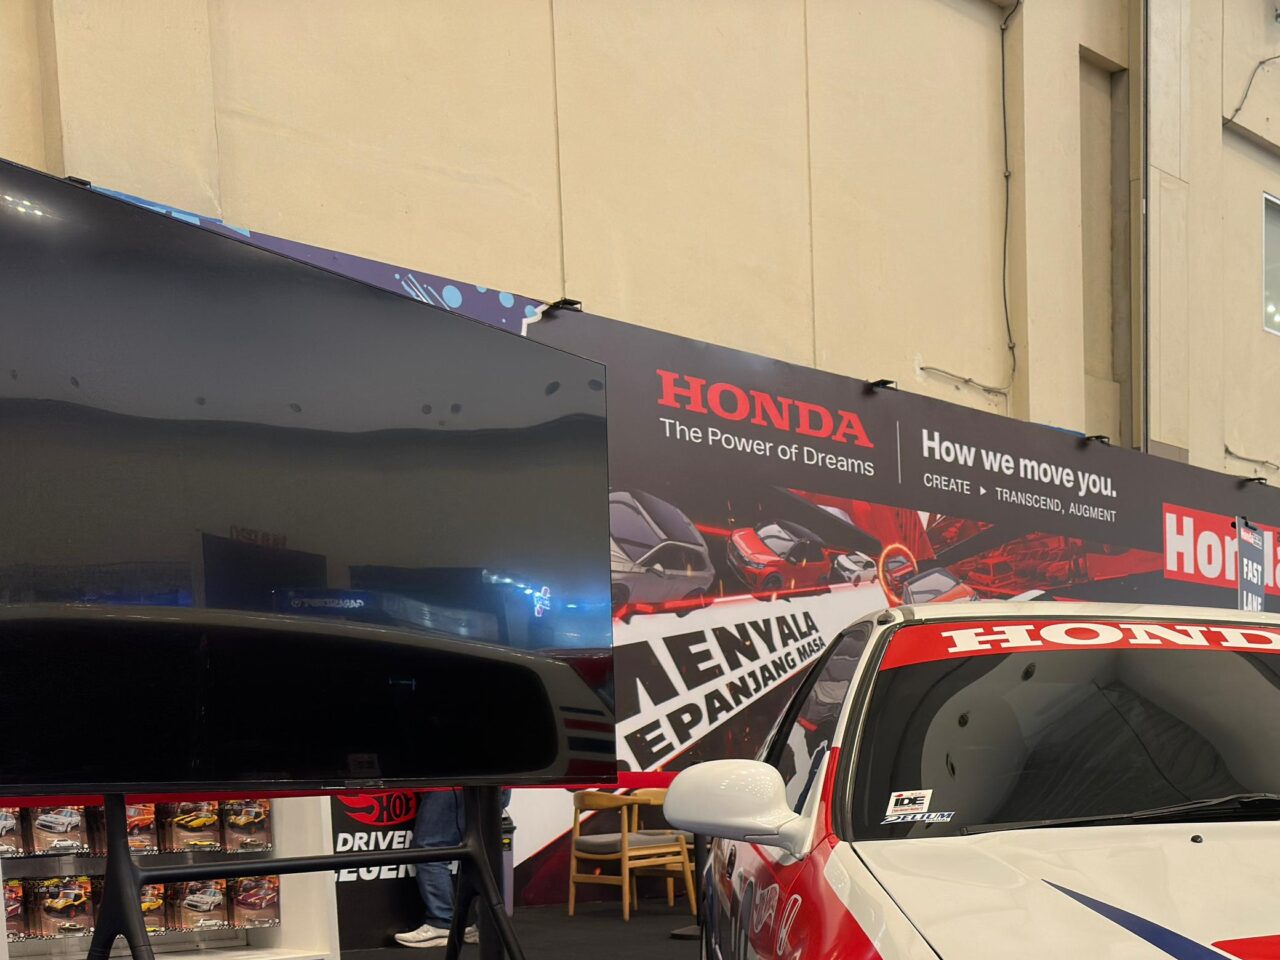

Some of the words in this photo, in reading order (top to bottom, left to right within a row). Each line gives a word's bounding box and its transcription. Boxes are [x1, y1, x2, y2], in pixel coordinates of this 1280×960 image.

[656, 368, 875, 448] HONDA
[659, 417, 703, 443] The
[708, 426, 773, 457] Power
[777, 444, 799, 462] of
[803, 446, 875, 476] Dreams
[922, 429, 976, 467] How
[981, 449, 1015, 475] we
[1019, 457, 1075, 488] move
[1077, 470, 1117, 498] you.
[923, 473, 971, 495] CREATE
[996, 487, 1065, 514] TRANSCEND,
[1069, 502, 1117, 522] AUGMENT
[1243, 557, 1262, 586] FAST
[1243, 590, 1262, 612] LANE
[617, 650, 797, 771] EPANJANG
[799, 636, 827, 663] MASA
